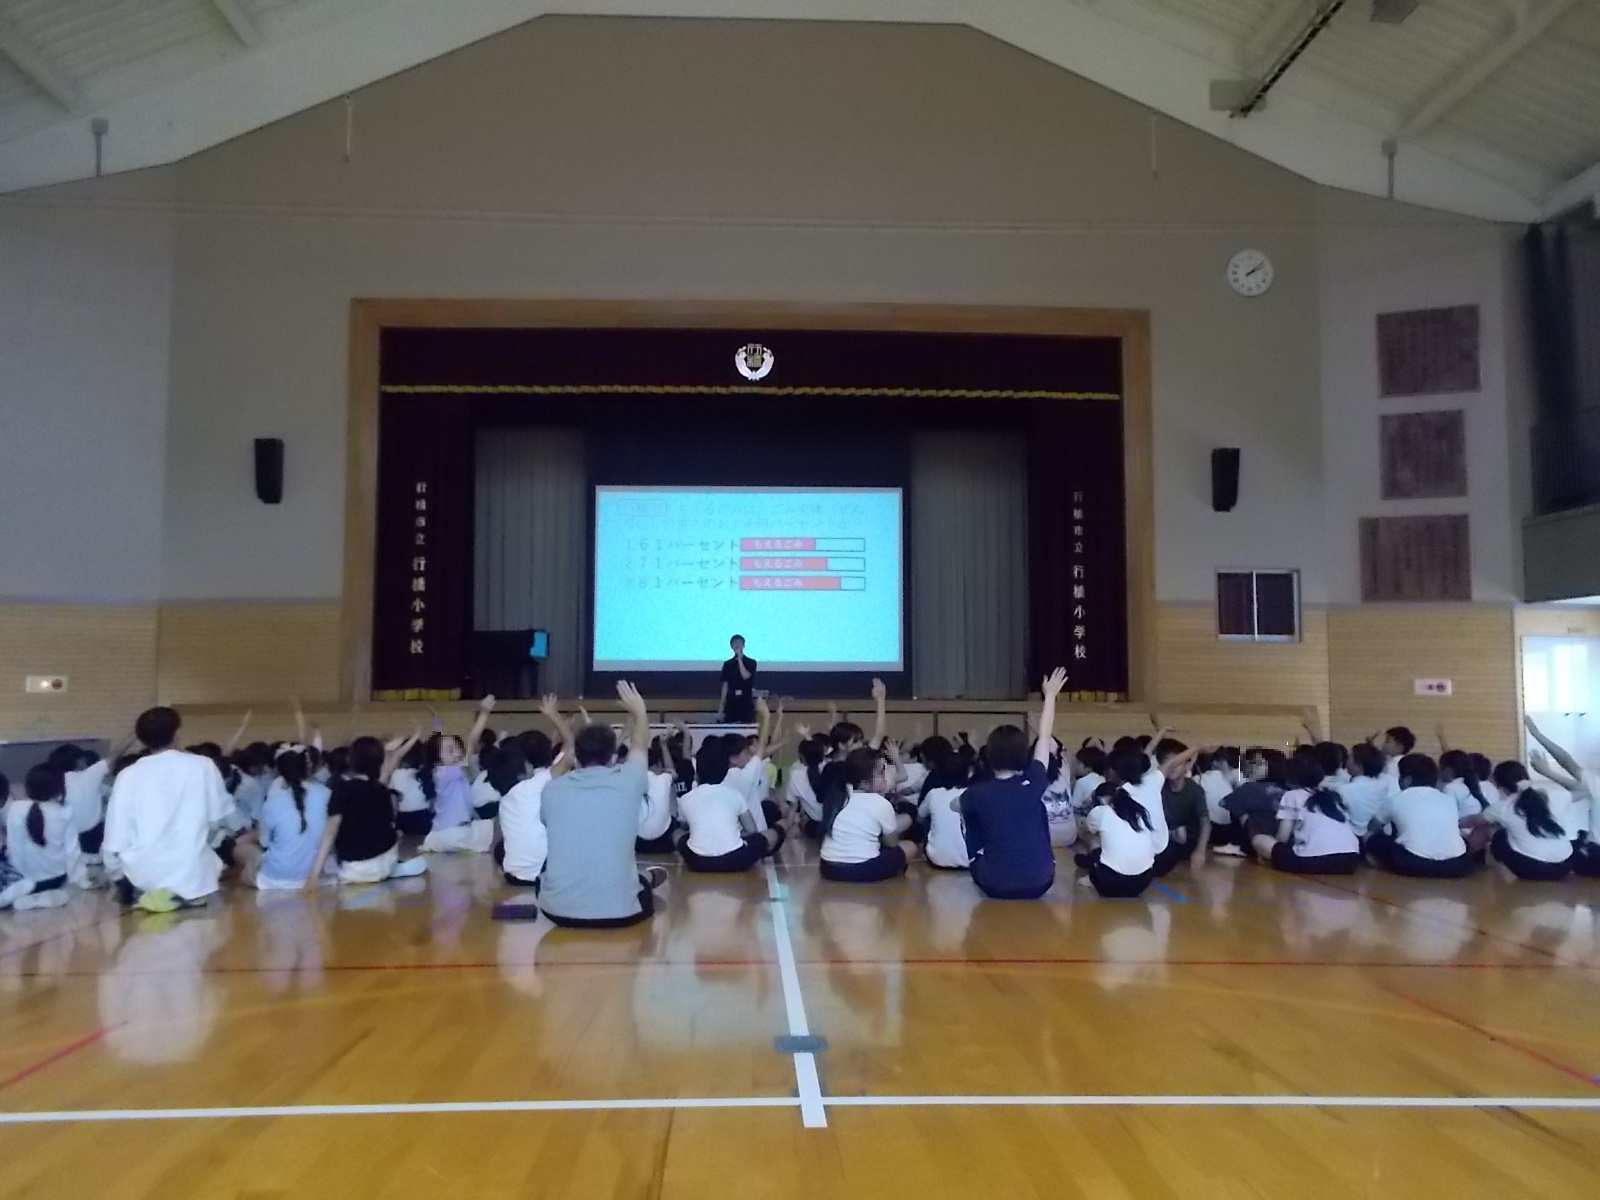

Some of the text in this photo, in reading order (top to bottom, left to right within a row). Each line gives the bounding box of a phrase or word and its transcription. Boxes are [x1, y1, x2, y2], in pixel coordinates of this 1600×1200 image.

[754, 539, 803, 549] もえるごみ
[754, 558, 803, 568] もえるごみ
[754, 577, 803, 588] もえるごみ
